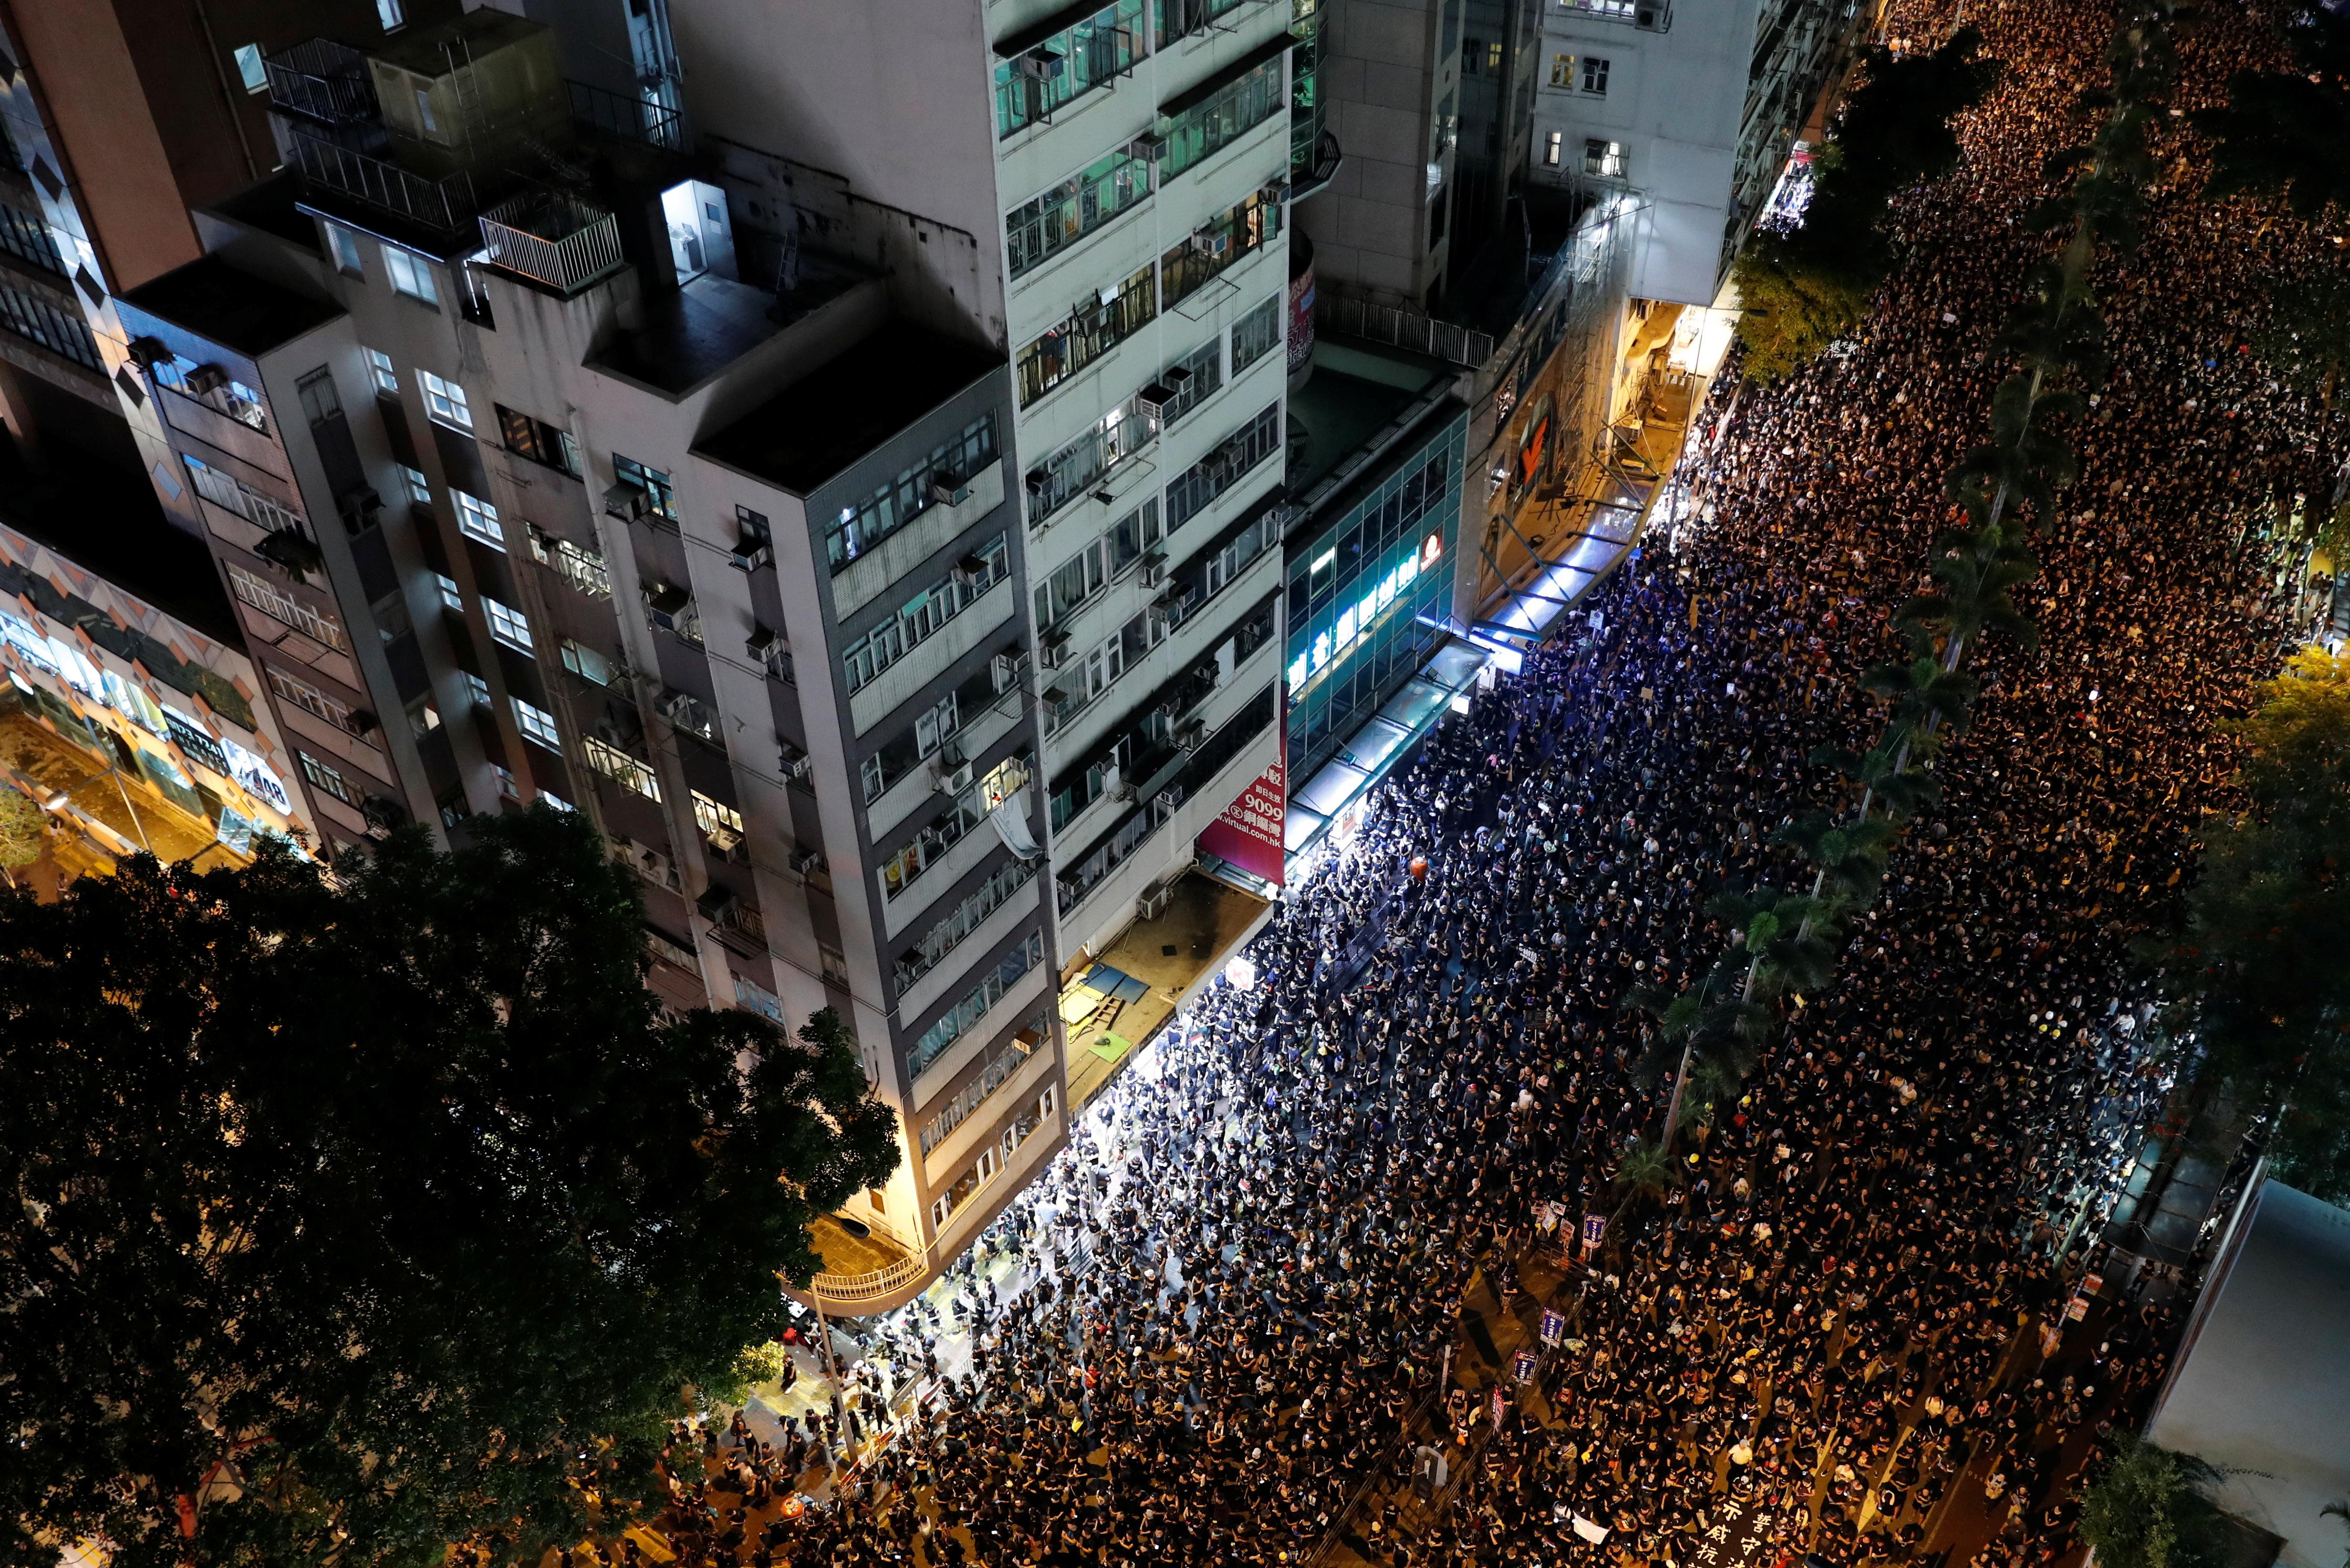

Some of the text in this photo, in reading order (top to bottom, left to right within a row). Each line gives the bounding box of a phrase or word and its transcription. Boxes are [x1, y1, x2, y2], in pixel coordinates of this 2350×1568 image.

[1245, 794, 1283, 821] 9099
[1256, 784, 1281, 804] 即日生效
[1243, 809, 1281, 837] 銅鑼灣
[1688, 1501, 1742, 1568] 示威抗
